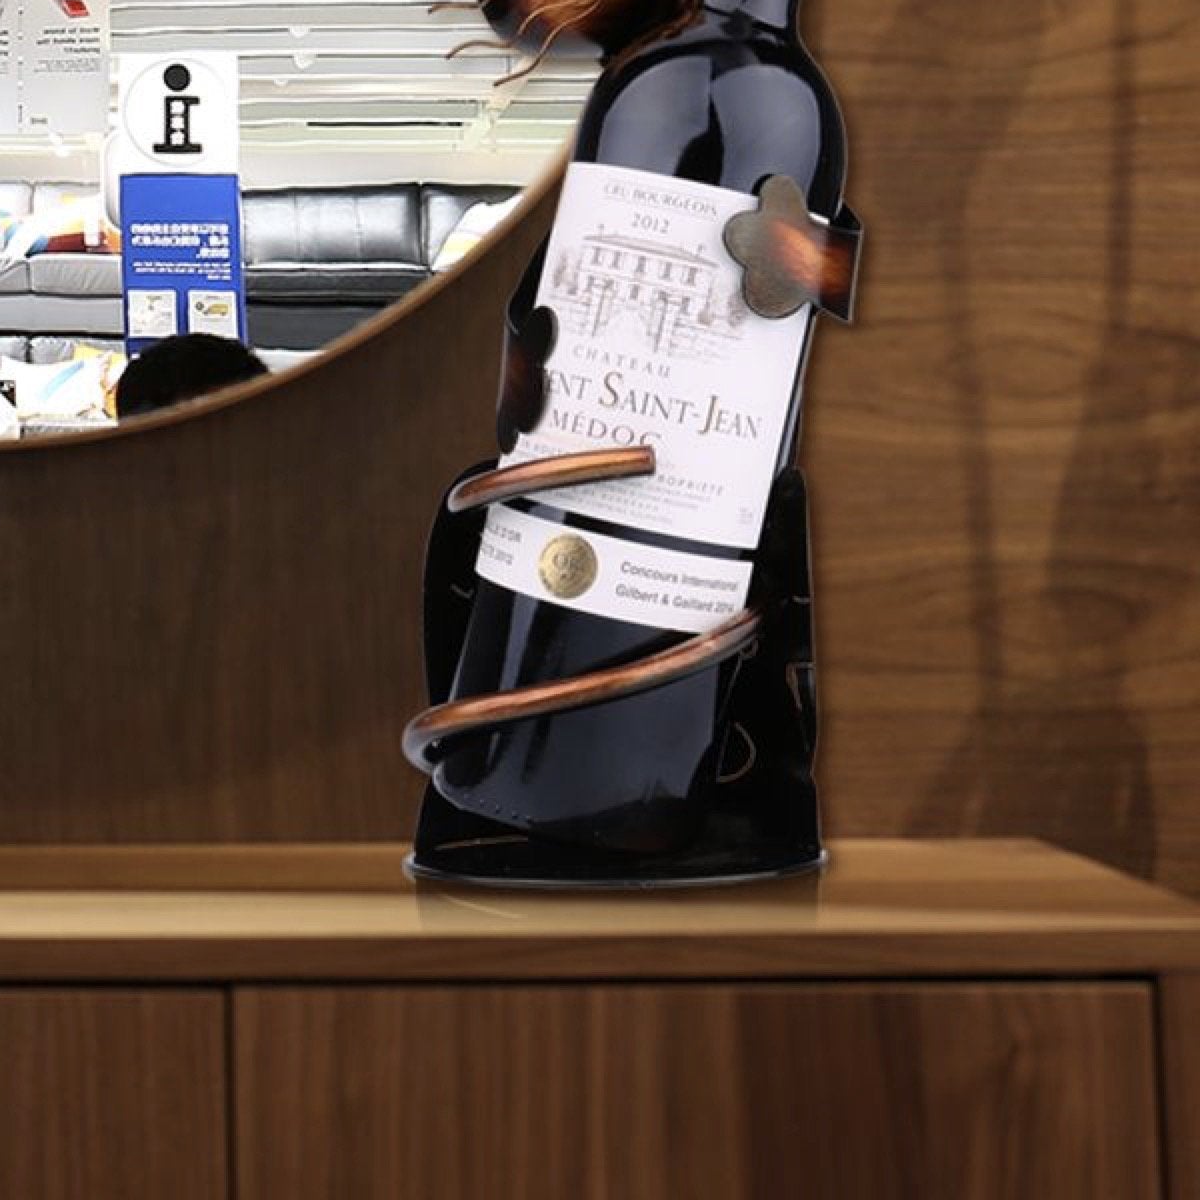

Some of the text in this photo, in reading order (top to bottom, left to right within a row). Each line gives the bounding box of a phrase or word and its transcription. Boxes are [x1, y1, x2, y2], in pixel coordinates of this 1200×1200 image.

[632, 213, 670, 233] 2012
[548, 369, 593, 400] ENT
[621, 561, 679, 583] Concours
[615, 583, 659, 602] Gilbert
